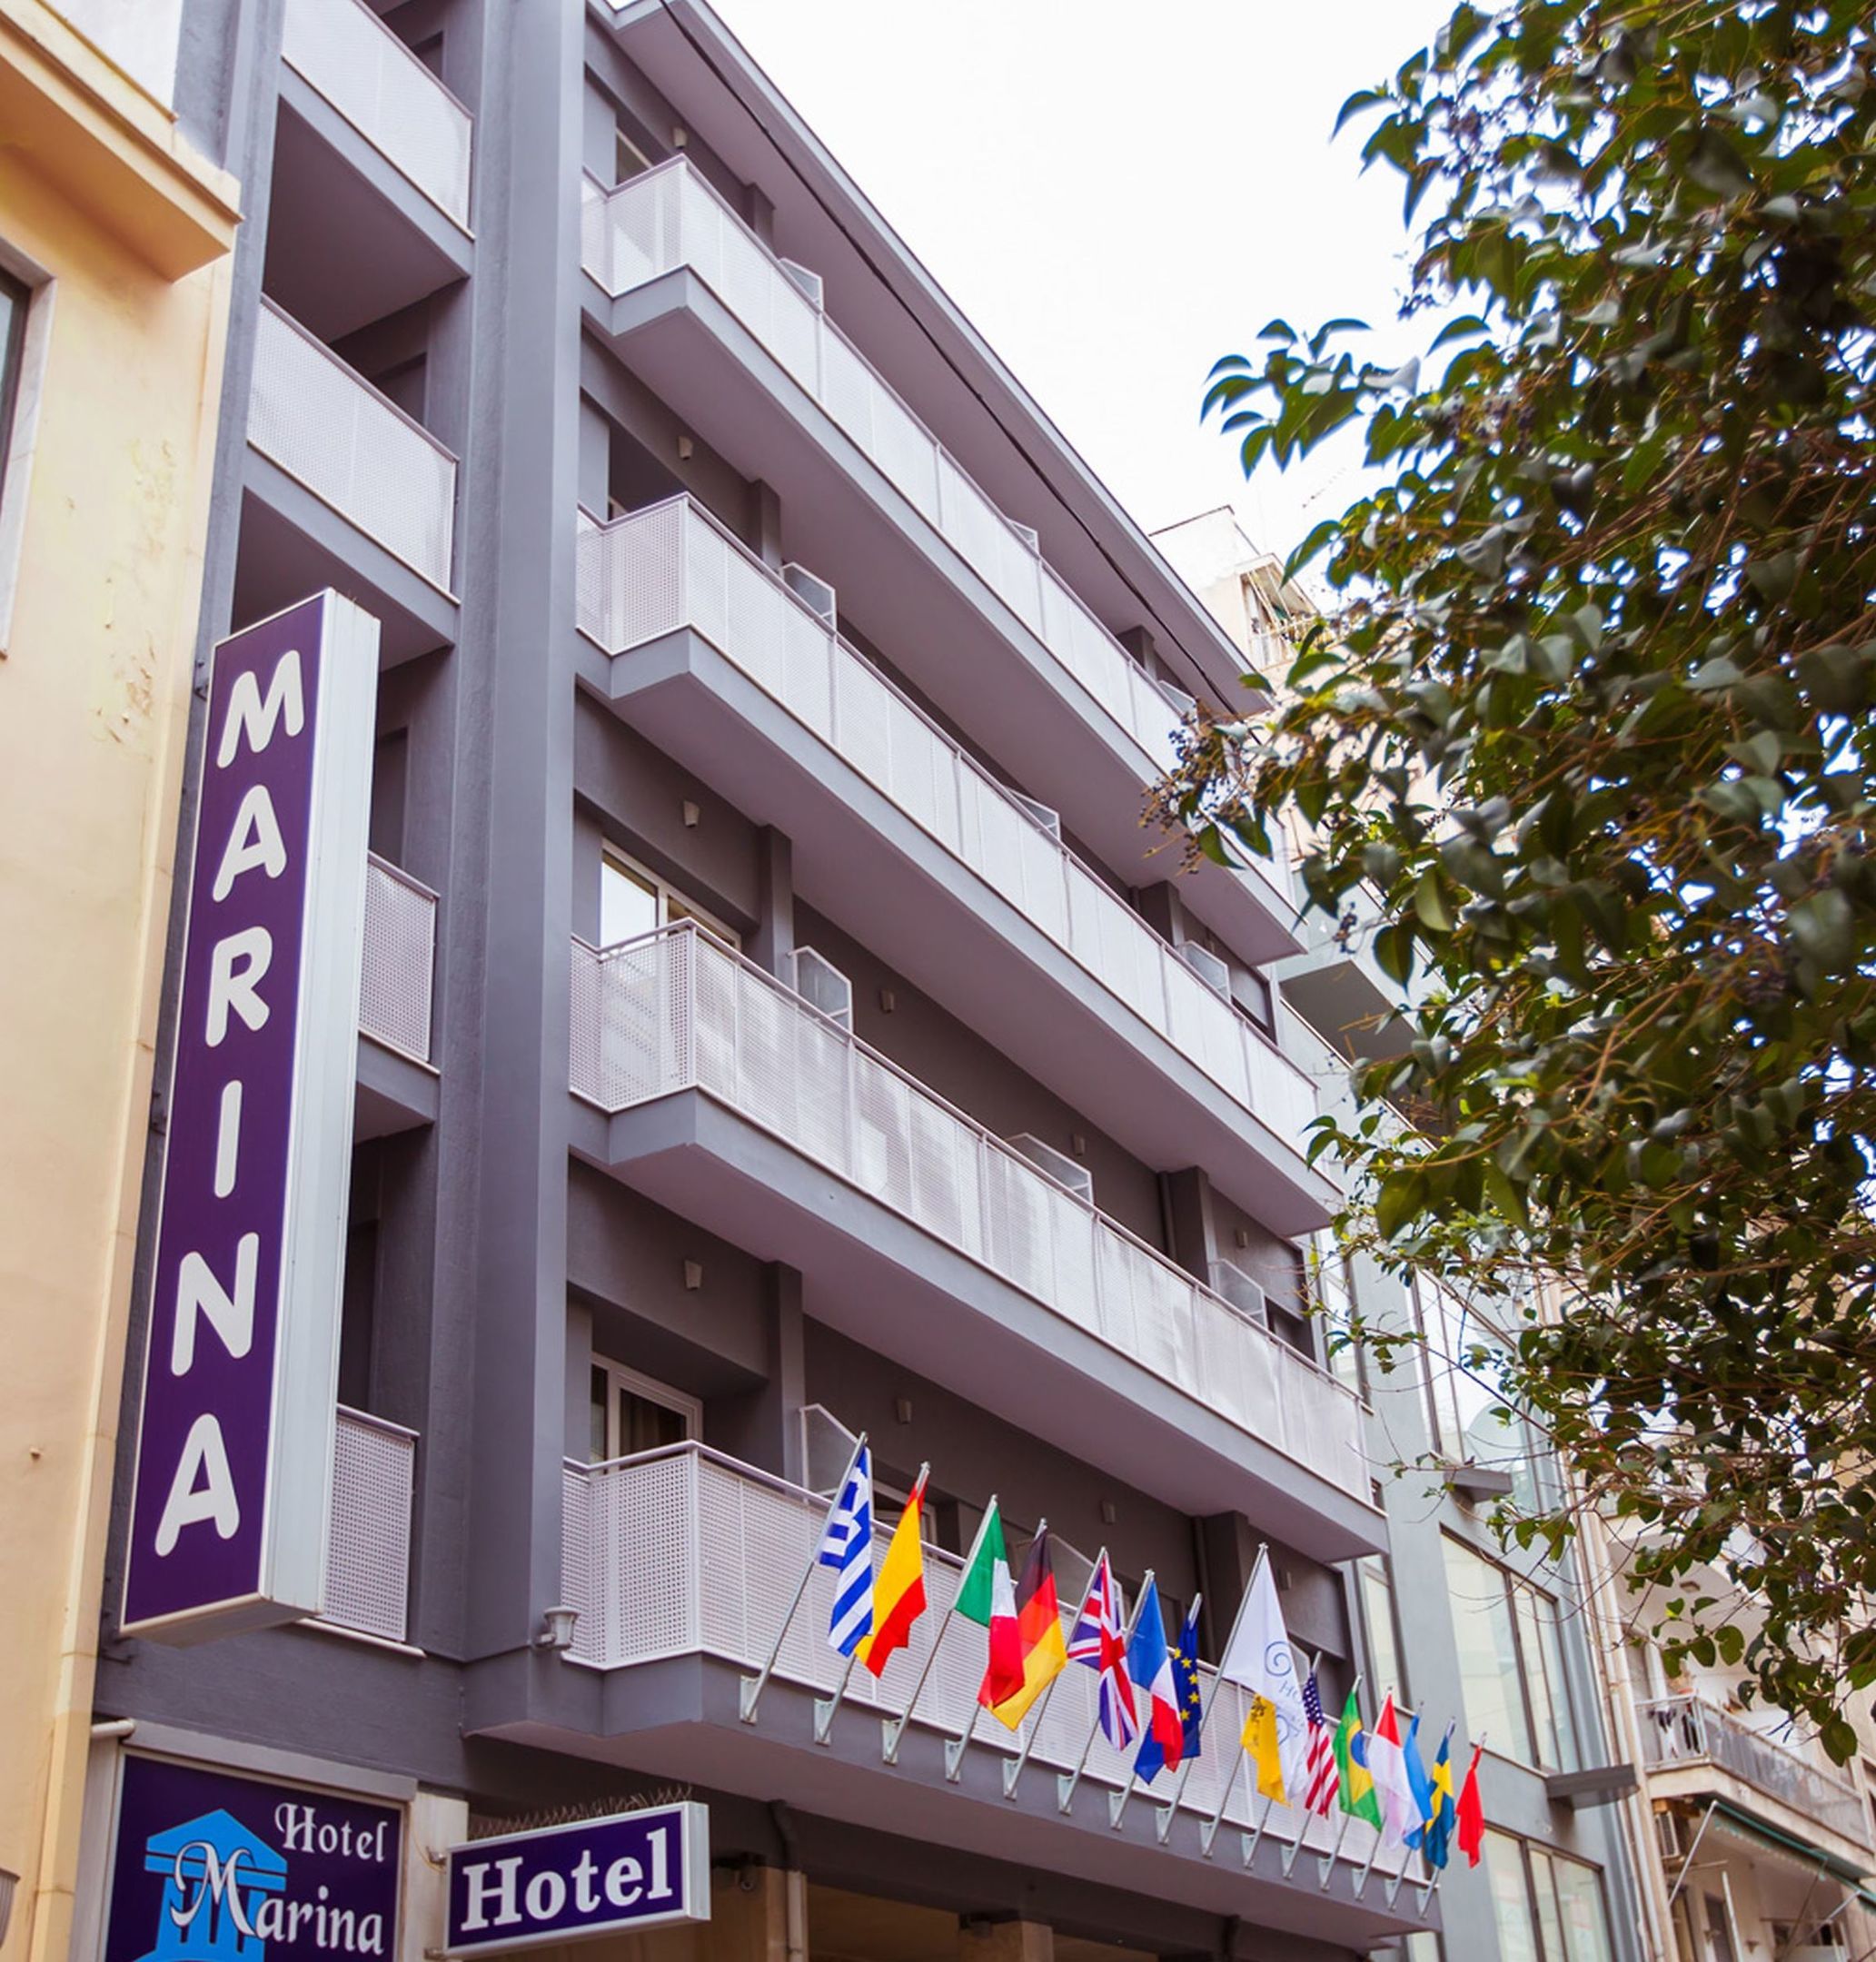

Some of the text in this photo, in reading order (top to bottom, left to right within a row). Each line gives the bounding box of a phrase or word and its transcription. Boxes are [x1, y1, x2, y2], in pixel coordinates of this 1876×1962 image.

[154, 649, 304, 1557] MARINA
[275, 1802, 386, 1862] Hotel
[460, 1827, 673, 1931] Hotel
[171, 1841, 383, 1955] Marina
